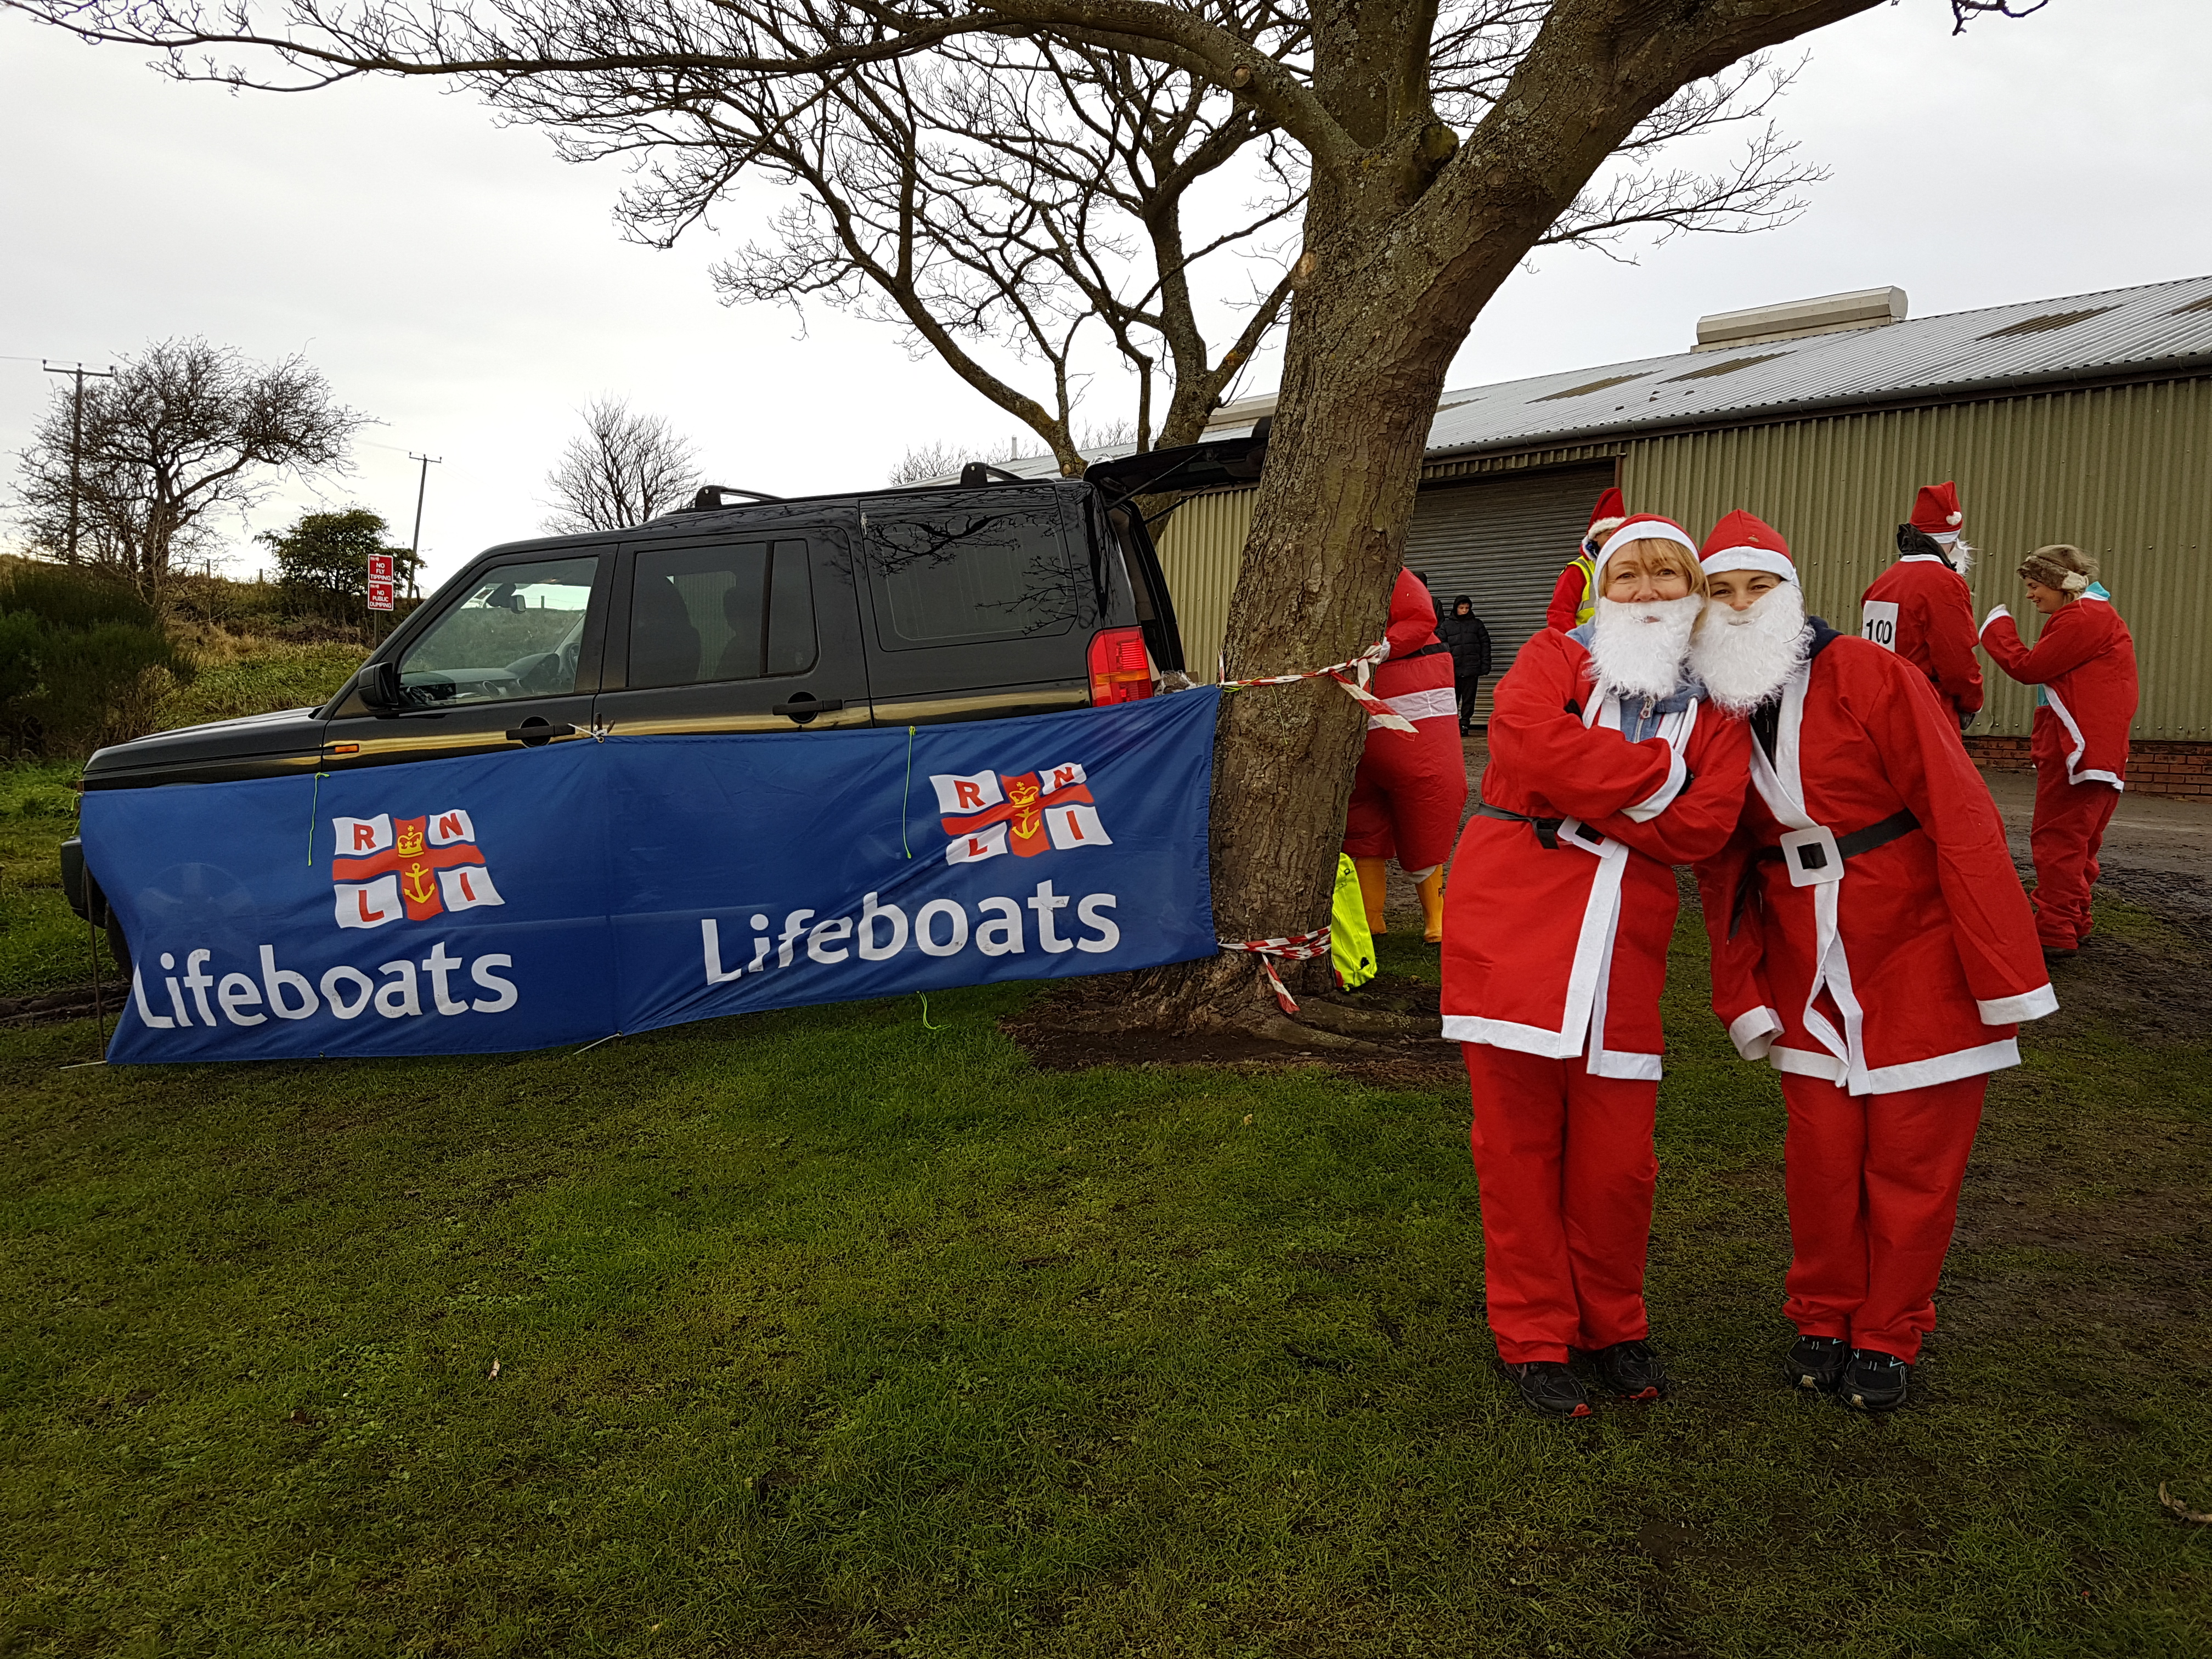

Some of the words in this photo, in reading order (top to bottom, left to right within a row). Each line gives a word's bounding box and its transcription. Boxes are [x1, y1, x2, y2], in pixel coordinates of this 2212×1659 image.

[1866, 619, 1893, 645] 100
[701, 879, 1120, 986] Lifeboats
[133, 941, 518, 1029] Lifeboats
